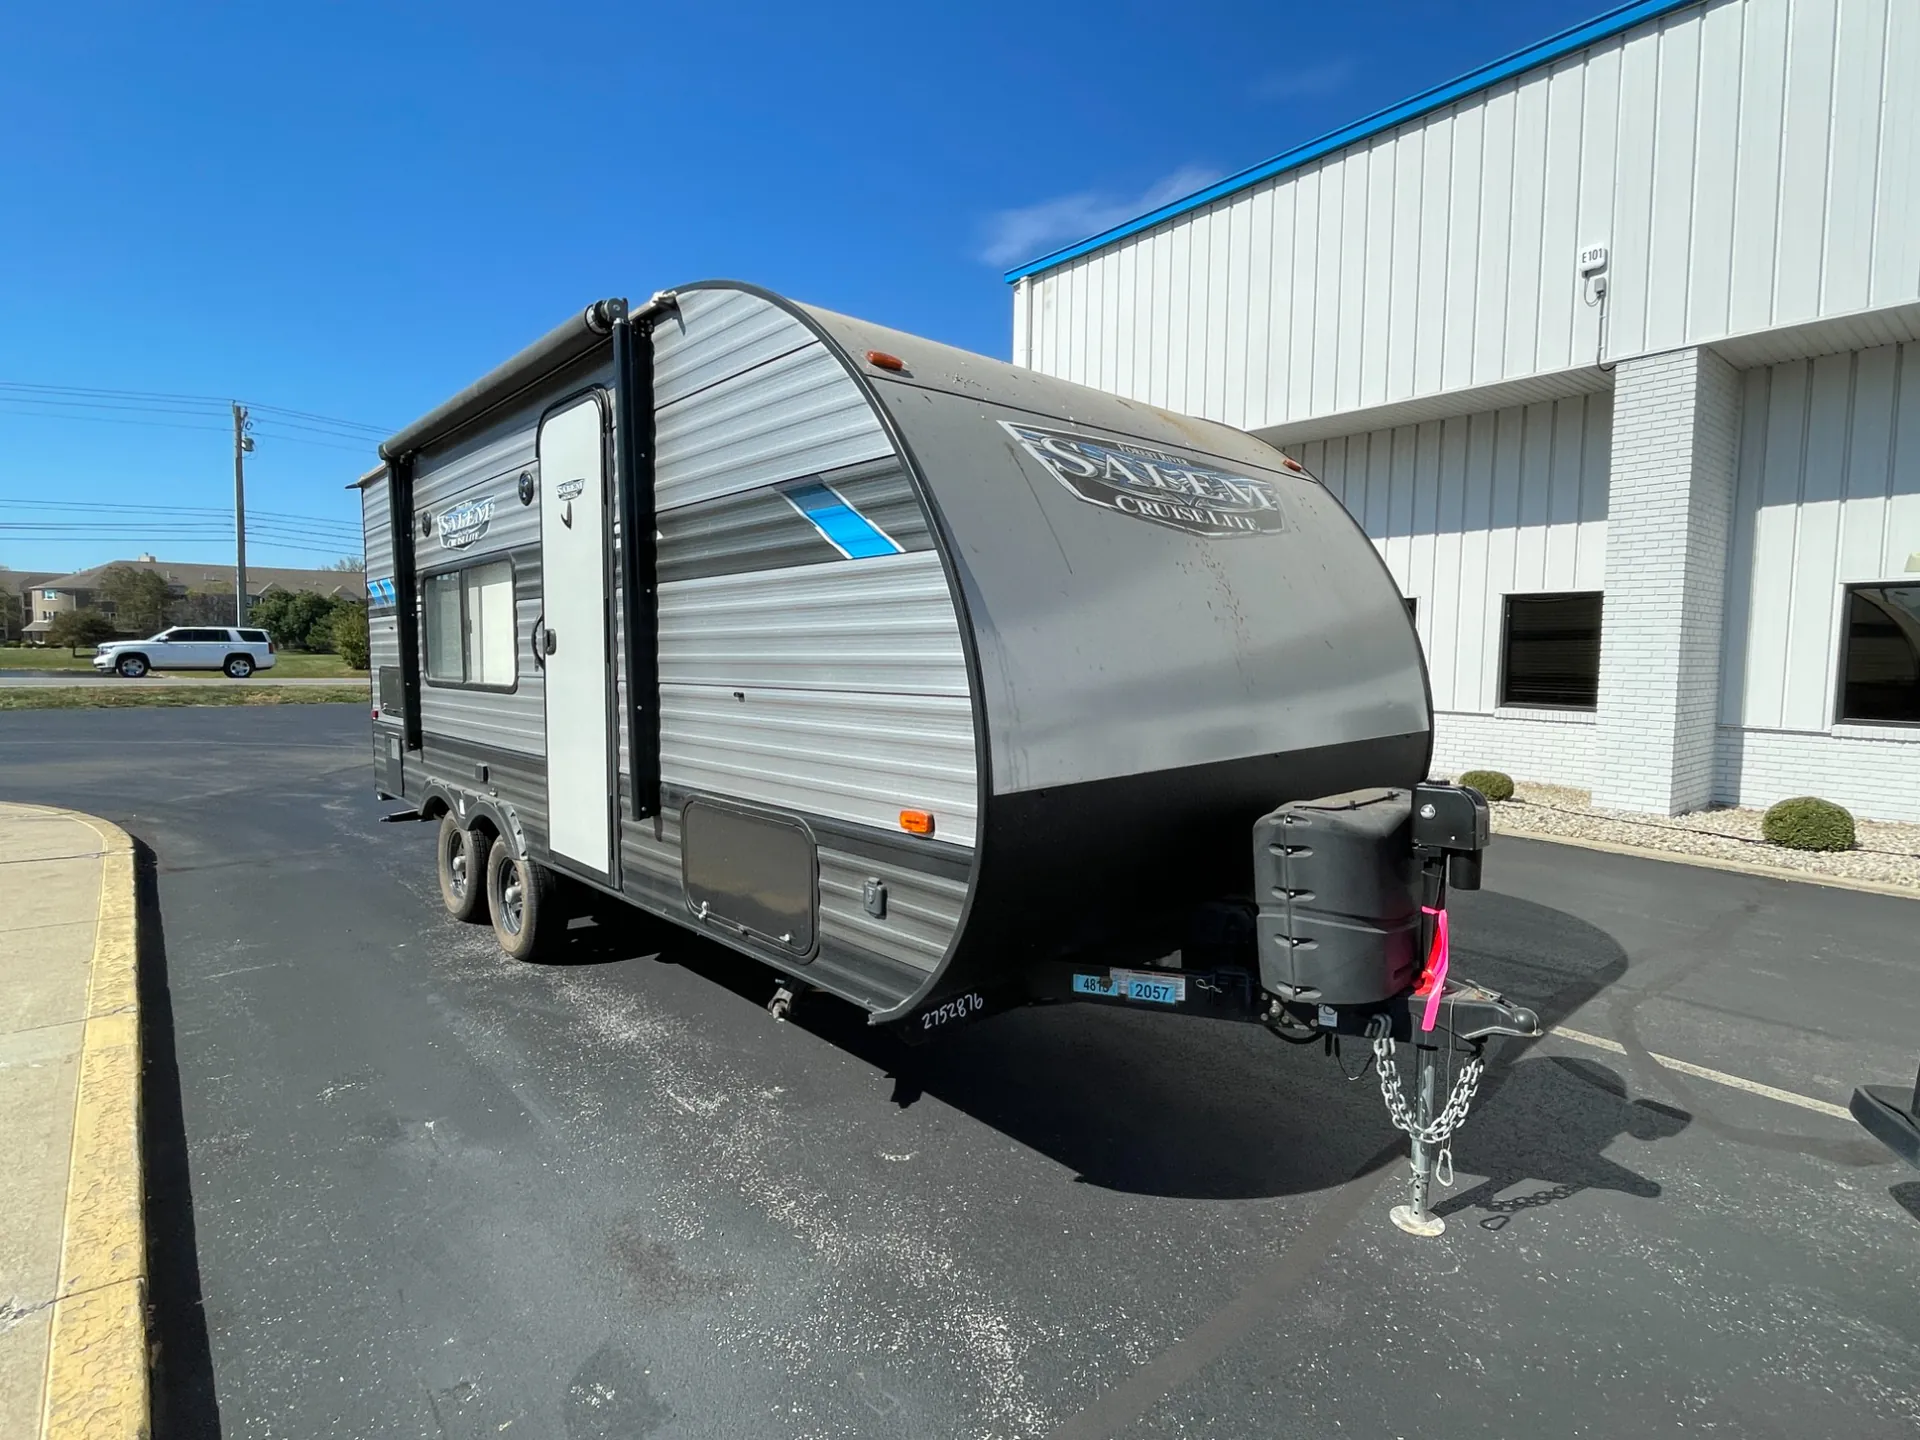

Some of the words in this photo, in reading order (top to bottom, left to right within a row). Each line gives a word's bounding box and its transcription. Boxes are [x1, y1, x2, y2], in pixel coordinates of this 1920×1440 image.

[1582, 248, 1602, 263] E101
[1039, 435, 1279, 511] SALEM
[441, 502, 492, 536] SALEM
[1135, 983, 1169, 1001] 2057
[921, 992, 984, 1030] 2752876
